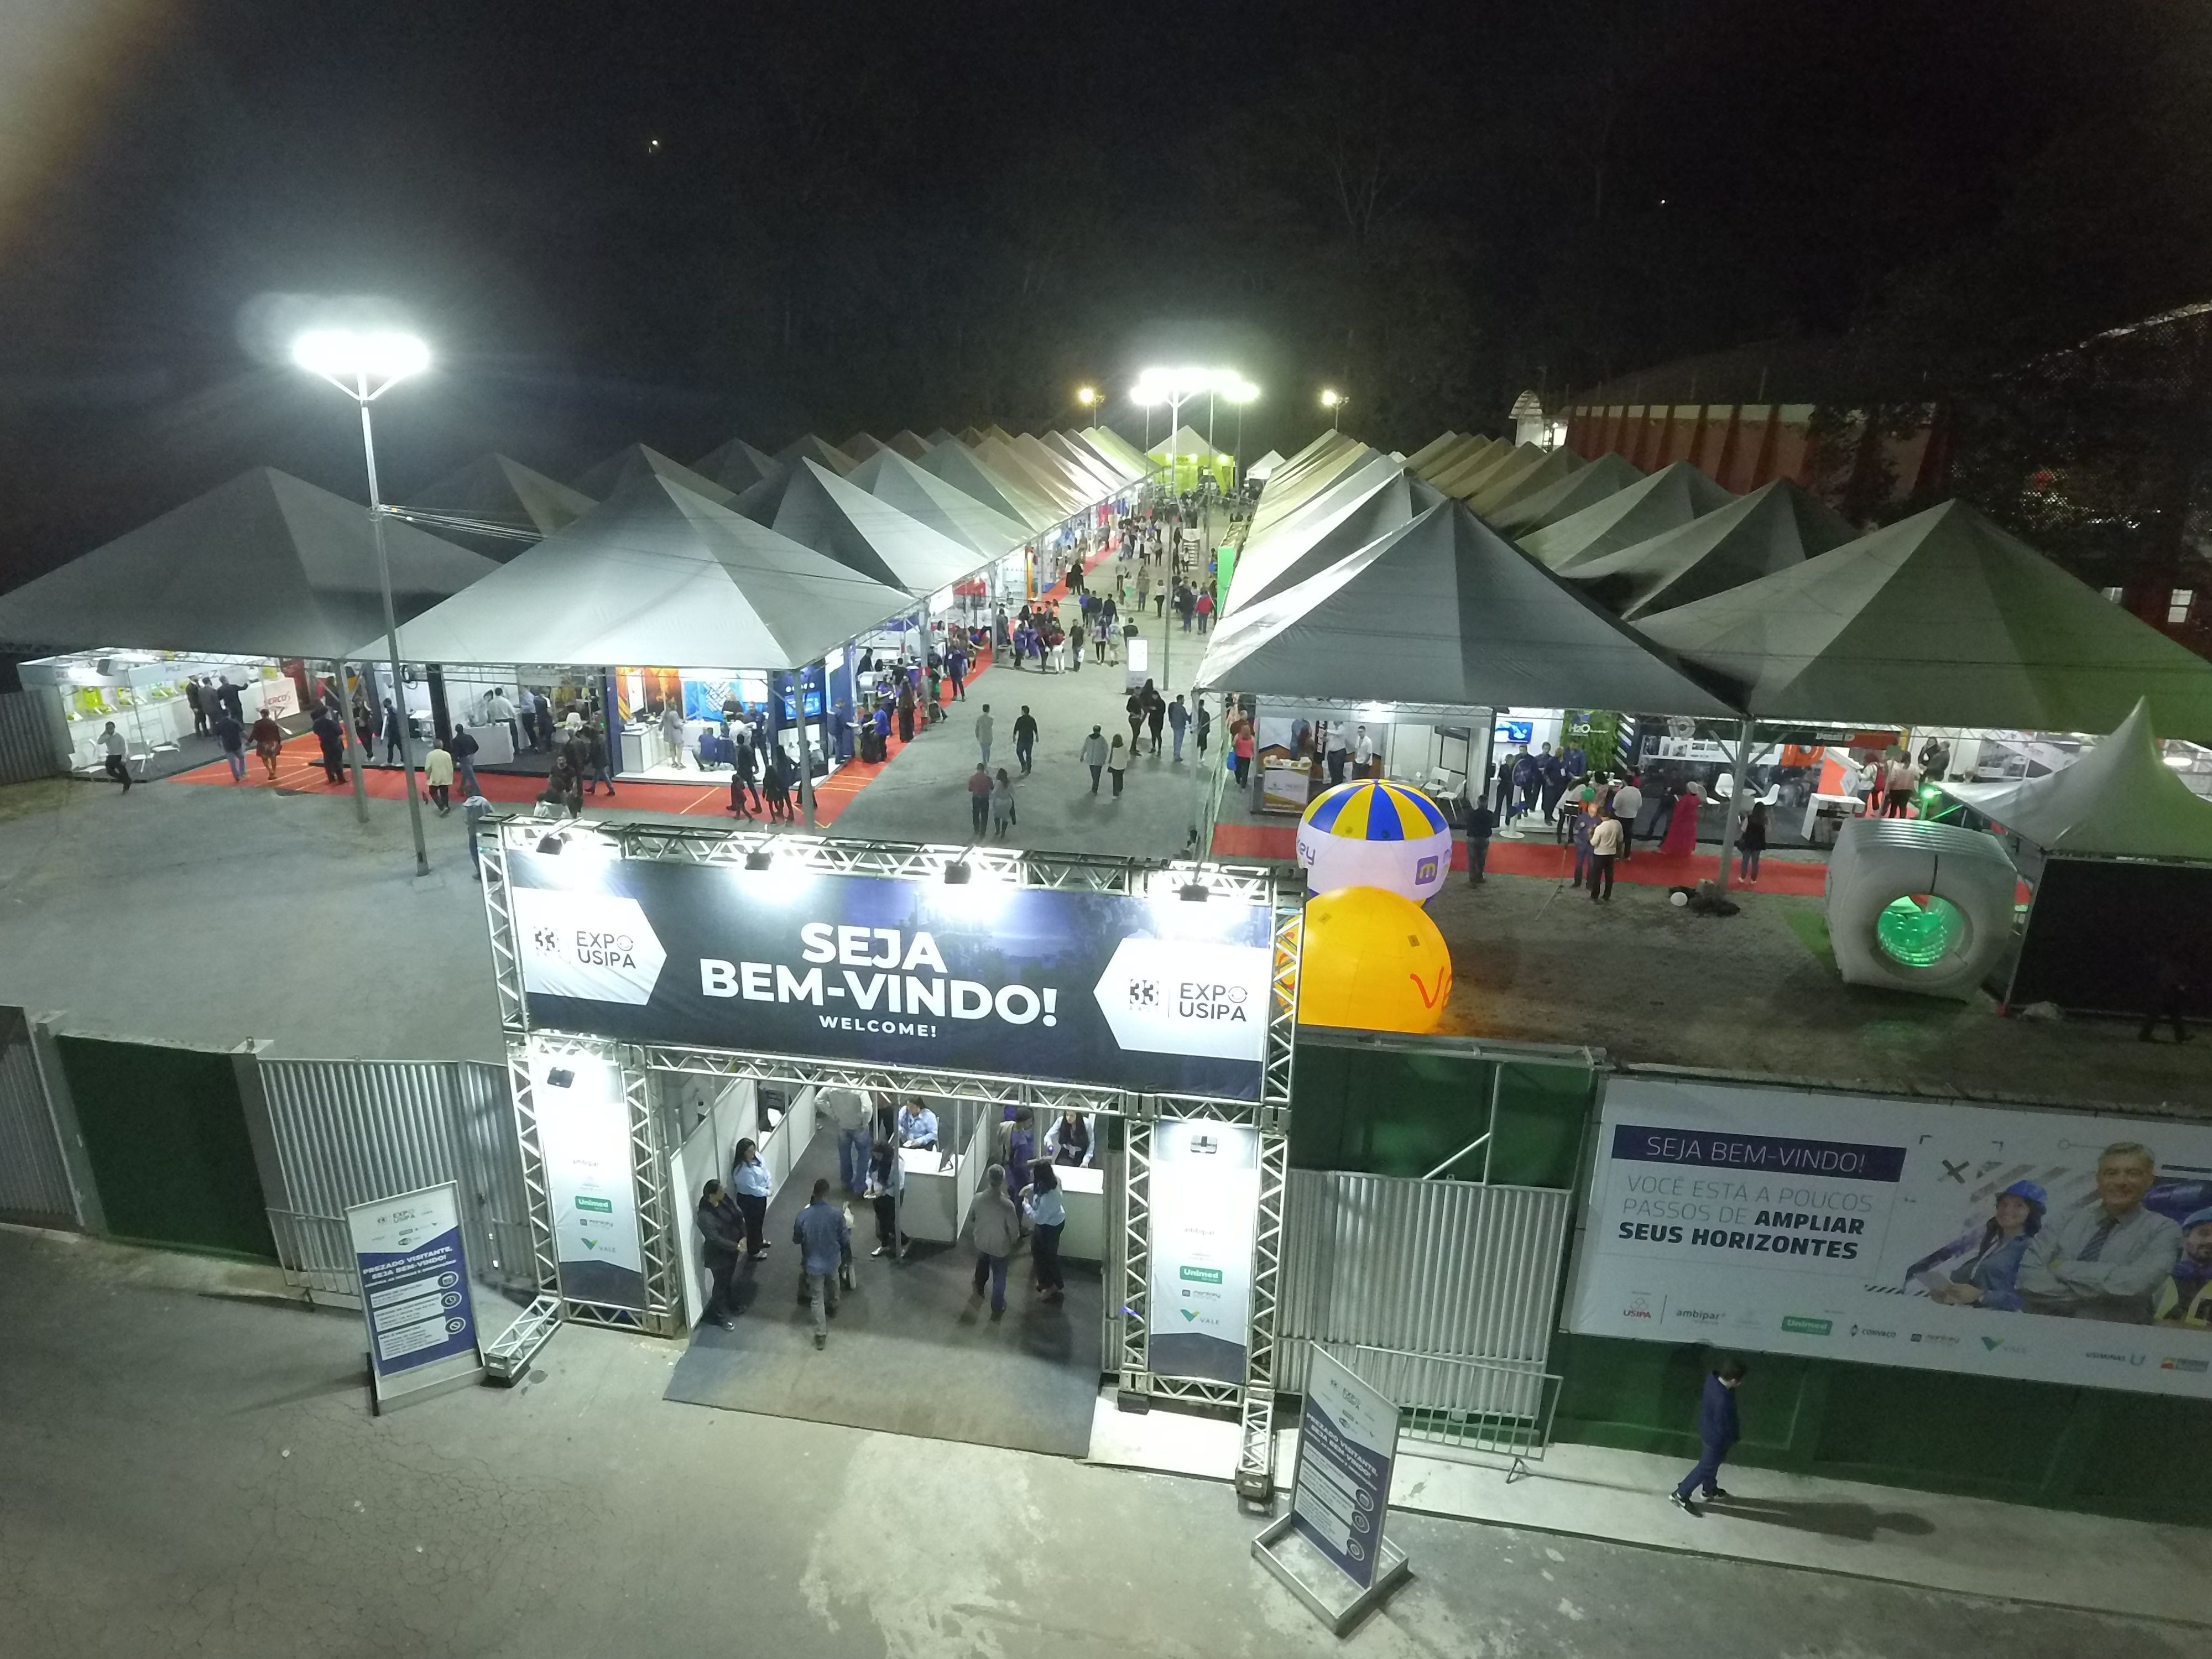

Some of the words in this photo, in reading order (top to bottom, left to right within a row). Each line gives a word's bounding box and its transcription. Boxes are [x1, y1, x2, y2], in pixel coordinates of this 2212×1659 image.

[1297, 839, 1316, 866] ey
[576, 930, 634, 952] EXPO
[801, 922, 948, 973] SEJA
[577, 948, 636, 969] USIPA
[700, 958, 1057, 1027] BEM-VINDO!
[1180, 982, 1248, 1004] EXPO
[1179, 1001, 1247, 1022] USIPA
[818, 1015, 937, 1038] WELCOME!
[1647, 1135, 1702, 1160] SEJA
[1710, 1141, 1866, 1173] BEM-VINDO!
[578, 1198, 609, 1208] Unimed
[1627, 1175, 1685, 1196] VOCÊ
[1692, 1180, 1748, 1201] ESTÁ
[1755, 1186, 1770, 1203] A
[1778, 1187, 1872, 1213] POUCOS
[1623, 1198, 1710, 1222] PASSOS
[1719, 1207, 1747, 1225] DE
[1754, 1209, 1865, 1235] AMPLIAR
[1618, 1222, 1684, 1244] SEUS
[1691, 1228, 1859, 1260] HORIZONTES
[363, 1260, 405, 1275] PREZADO
[372, 1270, 394, 1280] SEJA
[1183, 1268, 1219, 1279] Unimed
[1623, 1309, 1651, 1319] USIPA
[1676, 1309, 1720, 1321] ambipar
[1787, 1319, 1828, 1330] Unimed
